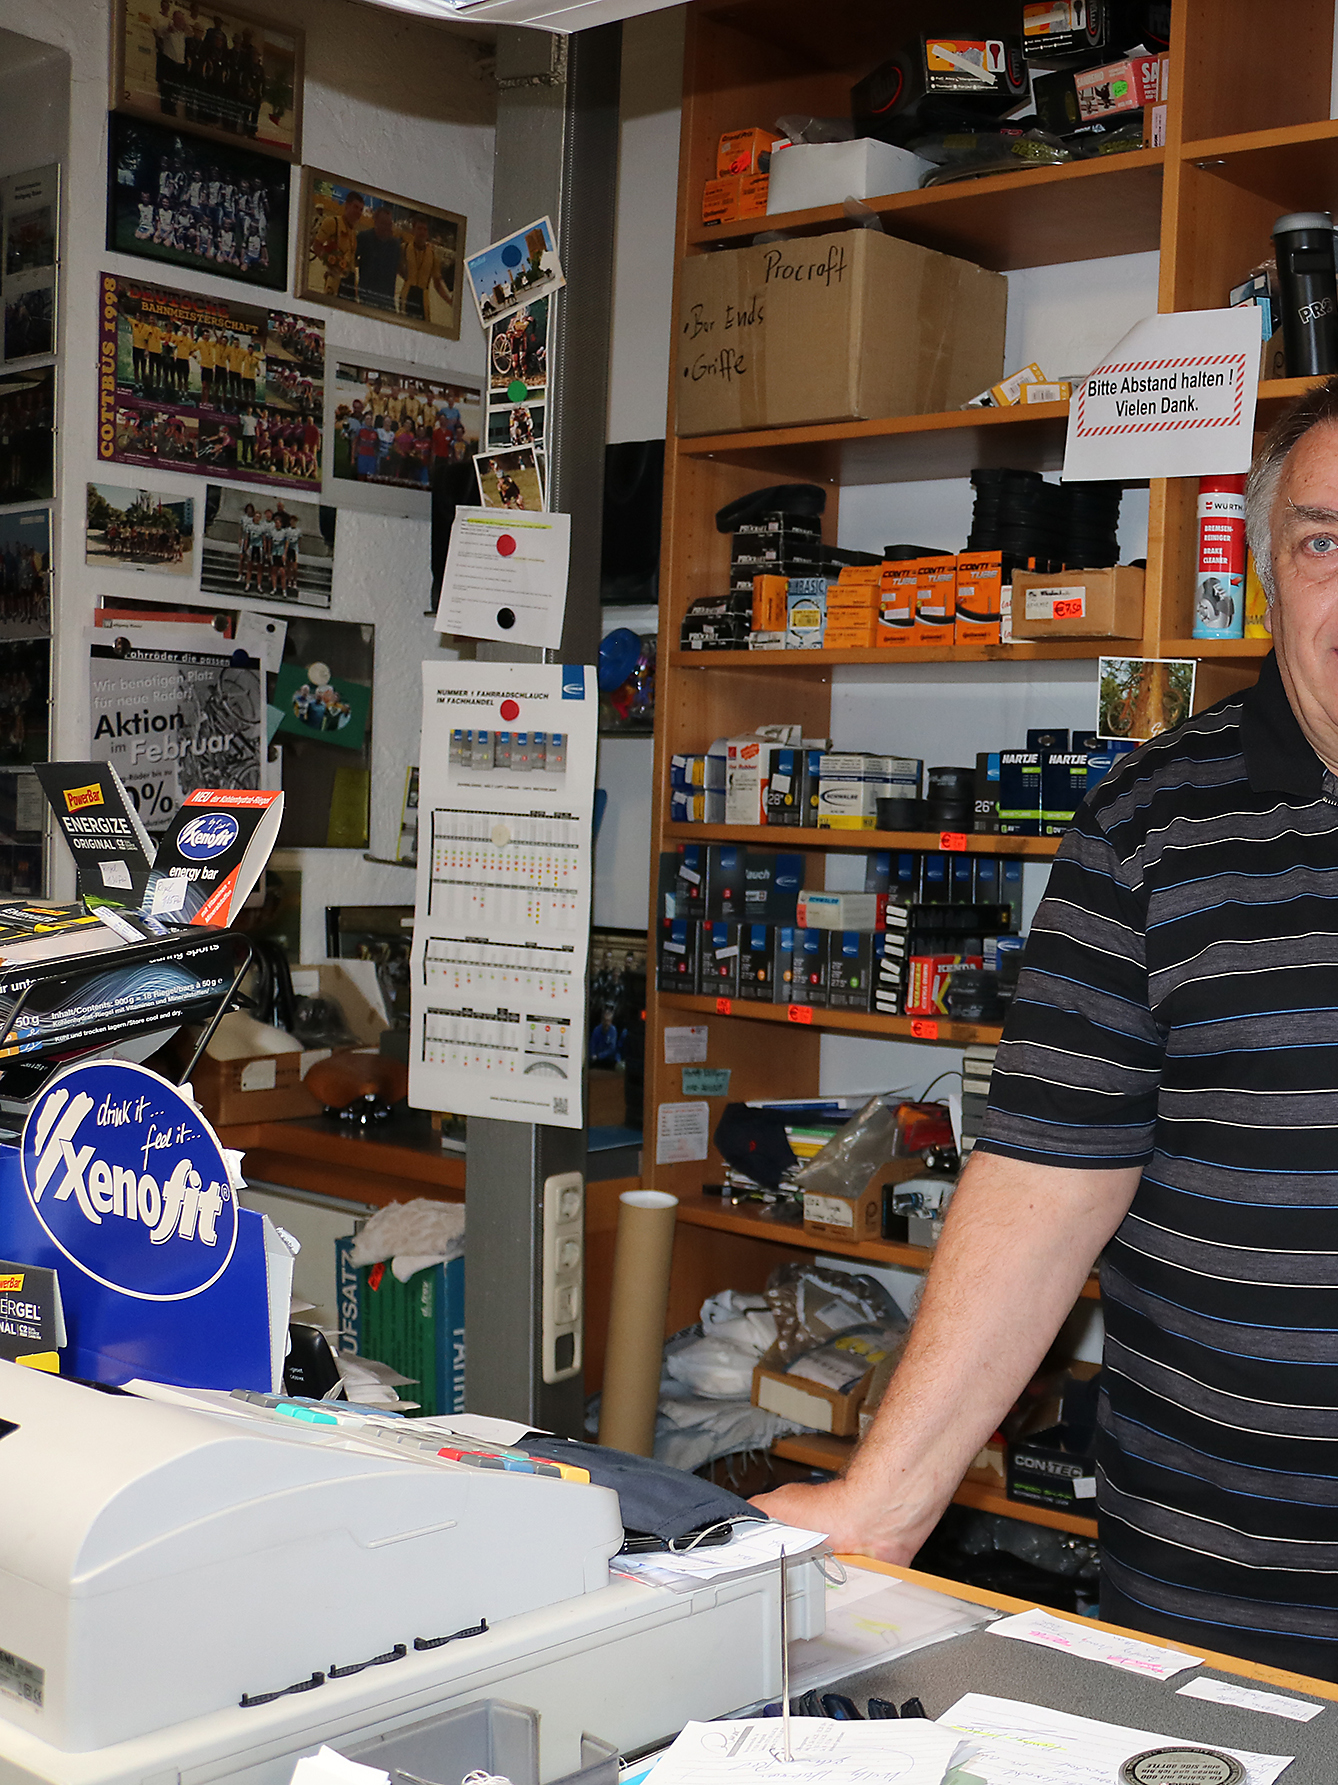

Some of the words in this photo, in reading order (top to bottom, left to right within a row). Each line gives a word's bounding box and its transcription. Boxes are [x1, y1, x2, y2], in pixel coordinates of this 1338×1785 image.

[764, 246, 848, 287] Procraft
[104, 277, 118, 333] 1998
[128, 284, 231, 319] DEUTSCHE
[141, 301, 260, 336] BAHNMEISTERSCHAFT
[725, 297, 765, 331] Ends
[691, 348, 748, 382] Griffe
[1088, 380, 1118, 398] Bitte
[1120, 373, 1177, 395] Abstand
[1181, 370, 1224, 389] halten
[1229, 368, 1234, 386] !
[101, 340, 117, 458] COTTBUS
[1116, 399, 1157, 417] Vielen
[1161, 394, 1199, 414] Dank.
[1203, 534, 1231, 542] REINIGER
[959, 562, 989, 571] CONTI
[1203, 556, 1229, 564] CLEANER
[882, 569, 910, 578] CONTI
[917, 566, 945, 576] CONTI
[928, 574, 953, 583] TUBE
[970, 570, 998, 579] TUBE
[892, 577, 917, 585] TUBE
[181, 653, 198, 663] die
[200, 656, 231, 667] passen
[93, 680, 116, 693] Wir
[120, 671, 184, 691] benötigen
[187, 669, 215, 683] Platz
[94, 696, 115, 709] für
[117, 694, 149, 707] neue
[436, 689, 468, 698] NUMMER
[476, 690, 549, 700] FAHRRADSCHLAUCH
[447, 698, 495, 707] FACHHANDEL
[94, 709, 184, 741] Aktion
[110, 741, 126, 754] im
[130, 732, 236, 767] Februar
[1002, 753, 1040, 765] HARTJE
[1048, 753, 1088, 766] HARTJE
[68, 788, 100, 808] PowerBar
[192, 791, 212, 803] NEU
[825, 792, 859, 801] SCHWALBE
[974, 800, 994, 814] 26"
[62, 817, 131, 834] ENERGIZE
[178, 818, 236, 848] Xenofit
[73, 838, 117, 851] ORIGINAL
[169, 866, 201, 883] energy
[201, 865, 219, 881] bar
[51, 999, 114, 1019] Inhalt/Contents:
[153, 984, 195, 999] Riegel/bars
[115, 1006, 125, 1014] mit
[125, 1000, 155, 1013] Vitaminen
[155, 999, 166, 1008] und
[70, 1031, 82, 1040] und
[83, 1025, 107, 1037] trocken
[107, 1017, 145, 1032] lagern/Store
[146, 1013, 159, 1022] cool
[159, 1011, 171, 1020] and
[171, 1009, 183, 1019] dry.
[97, 1093, 131, 1127] drink
[140, 1125, 173, 1171] feel
[50, 1138, 223, 1247] Xenofit
